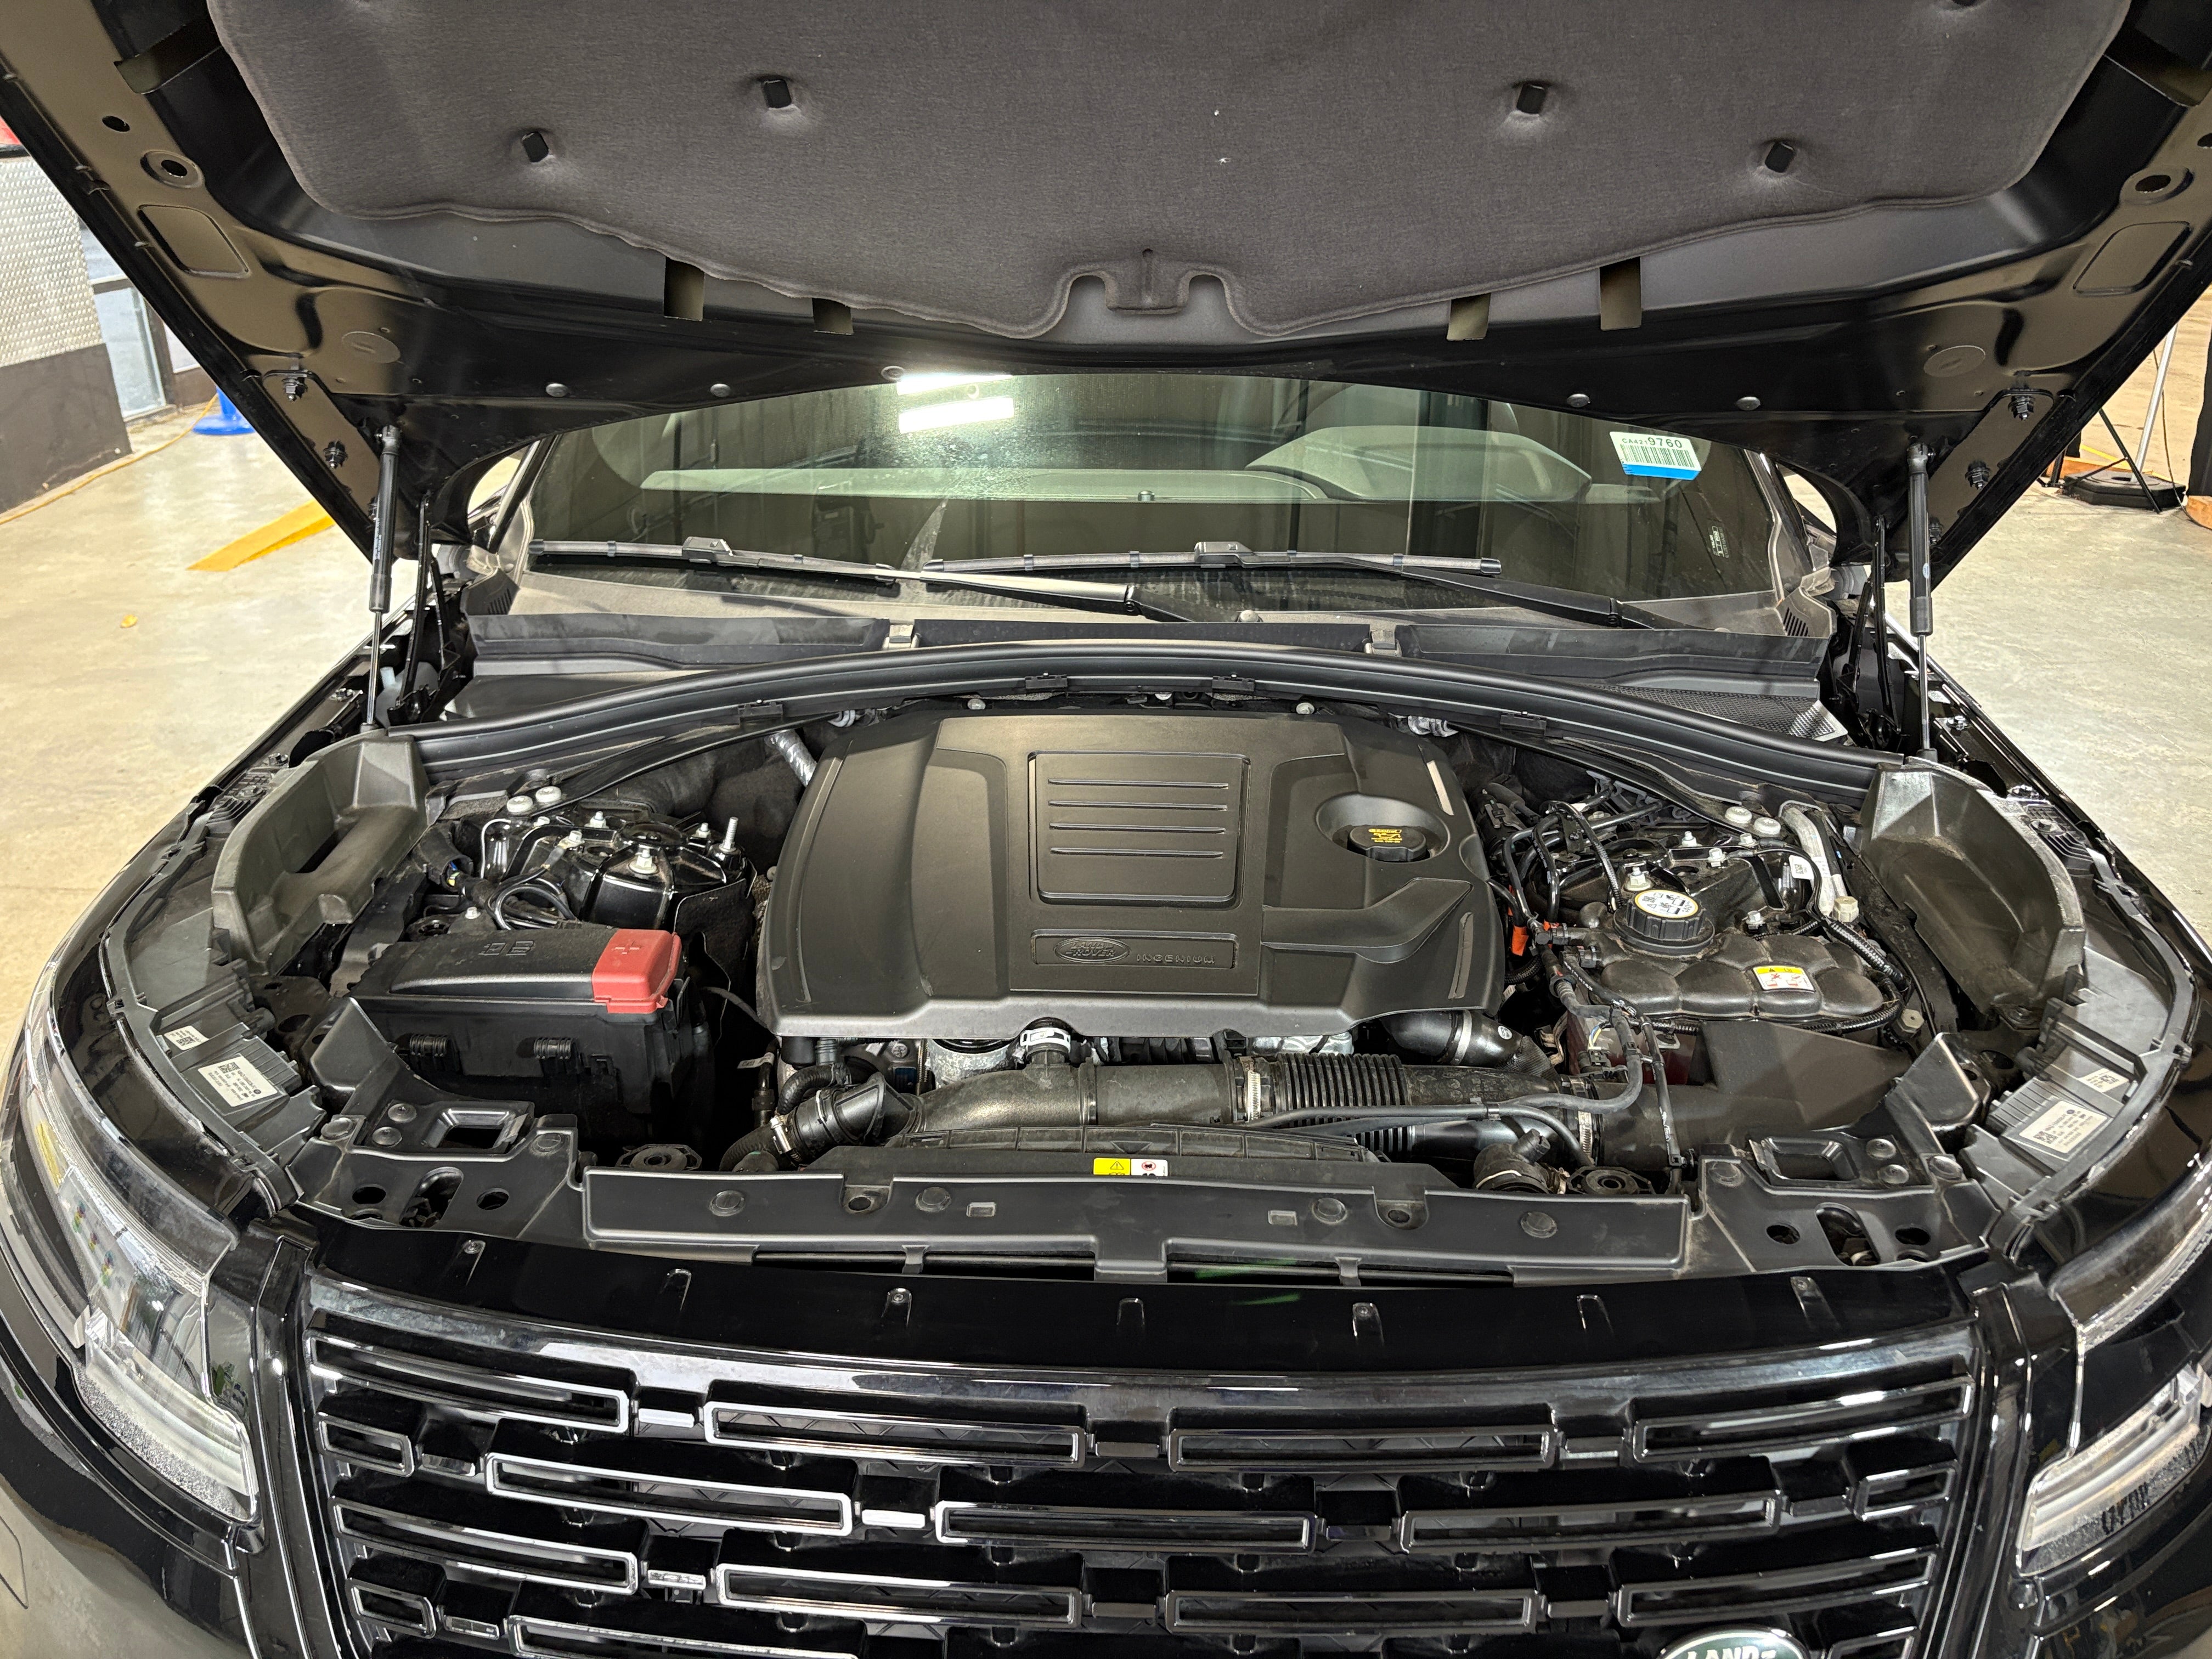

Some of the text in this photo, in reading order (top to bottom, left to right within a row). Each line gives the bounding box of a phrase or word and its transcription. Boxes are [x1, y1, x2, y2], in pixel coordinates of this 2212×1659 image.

[1622, 437, 1683, 448] CA4219760
[1072, 949, 1116, 957] ROVER
[1136, 953, 1216, 964] INGENIUM
